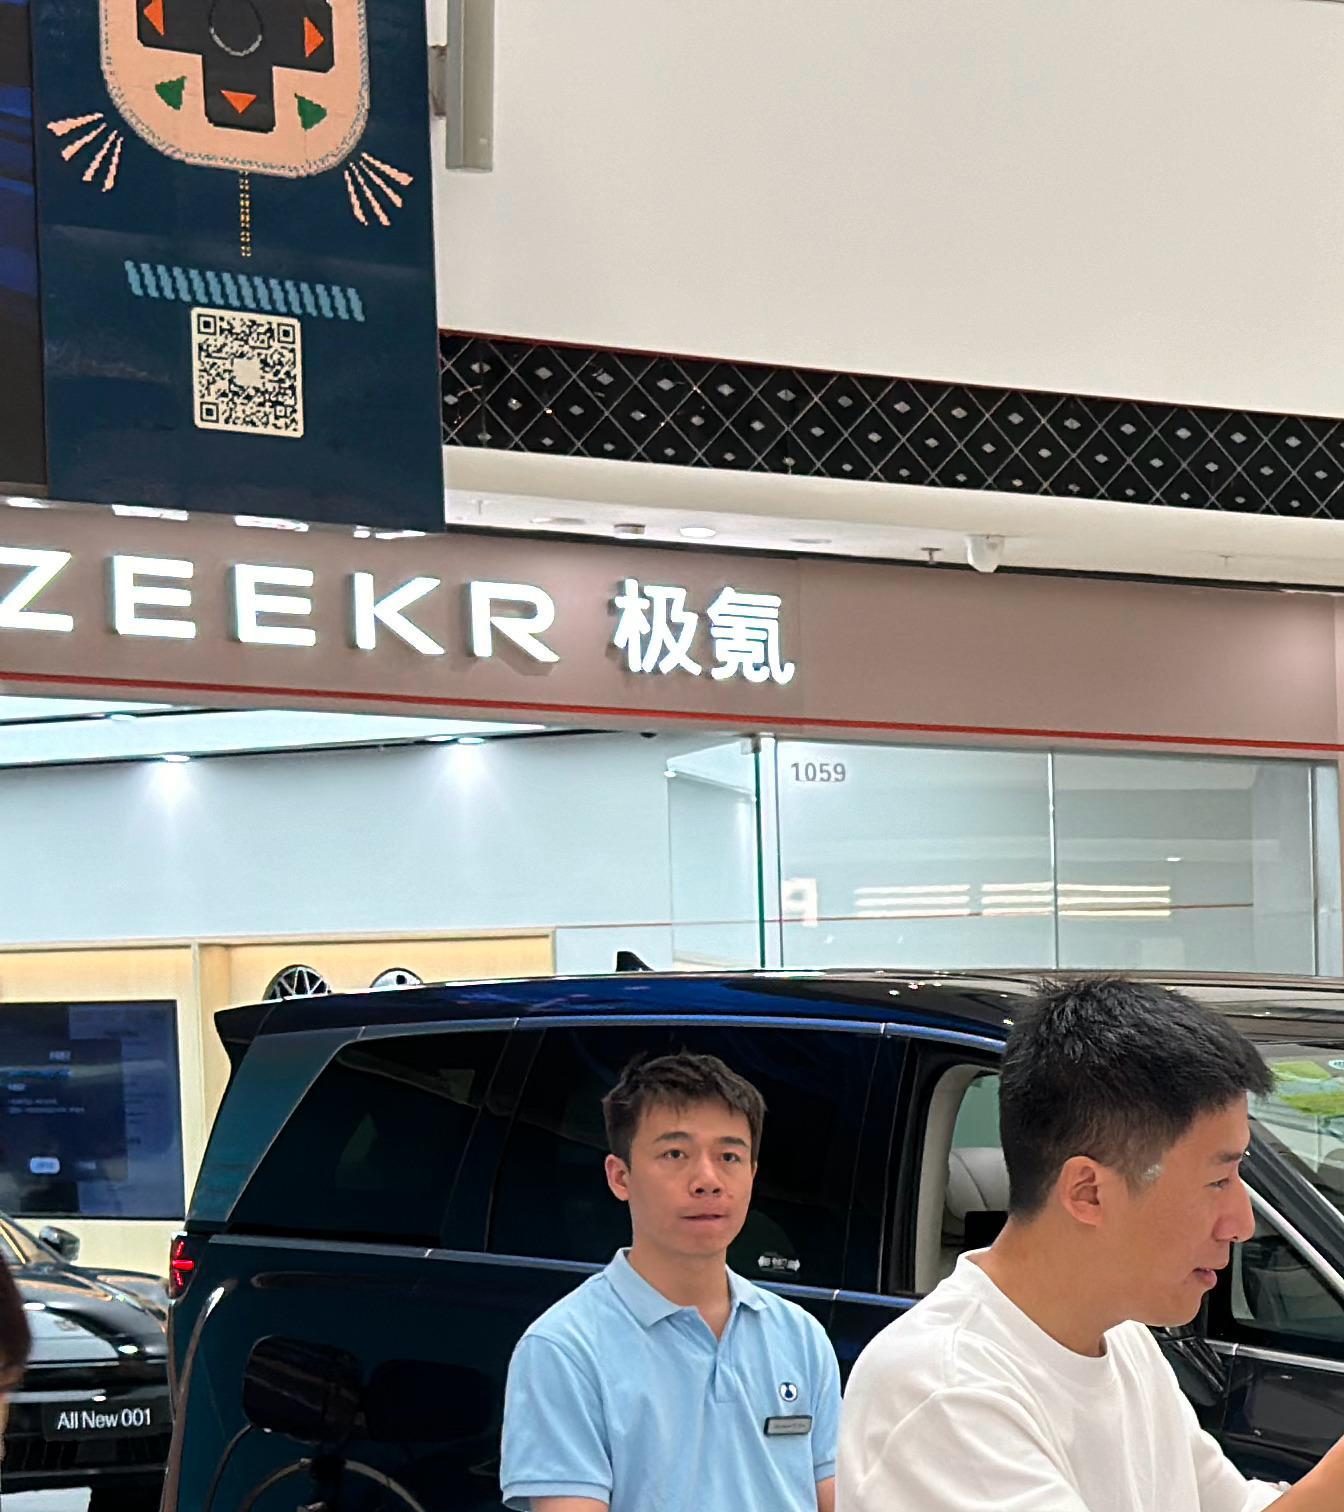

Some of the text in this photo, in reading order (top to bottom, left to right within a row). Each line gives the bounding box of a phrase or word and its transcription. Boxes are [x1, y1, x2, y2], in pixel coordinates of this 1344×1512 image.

[0, 546, 796, 686] ZEEKR 极氪
[790, 761, 847, 783] 1059
[57, 1407, 151, 1430] All New 001
